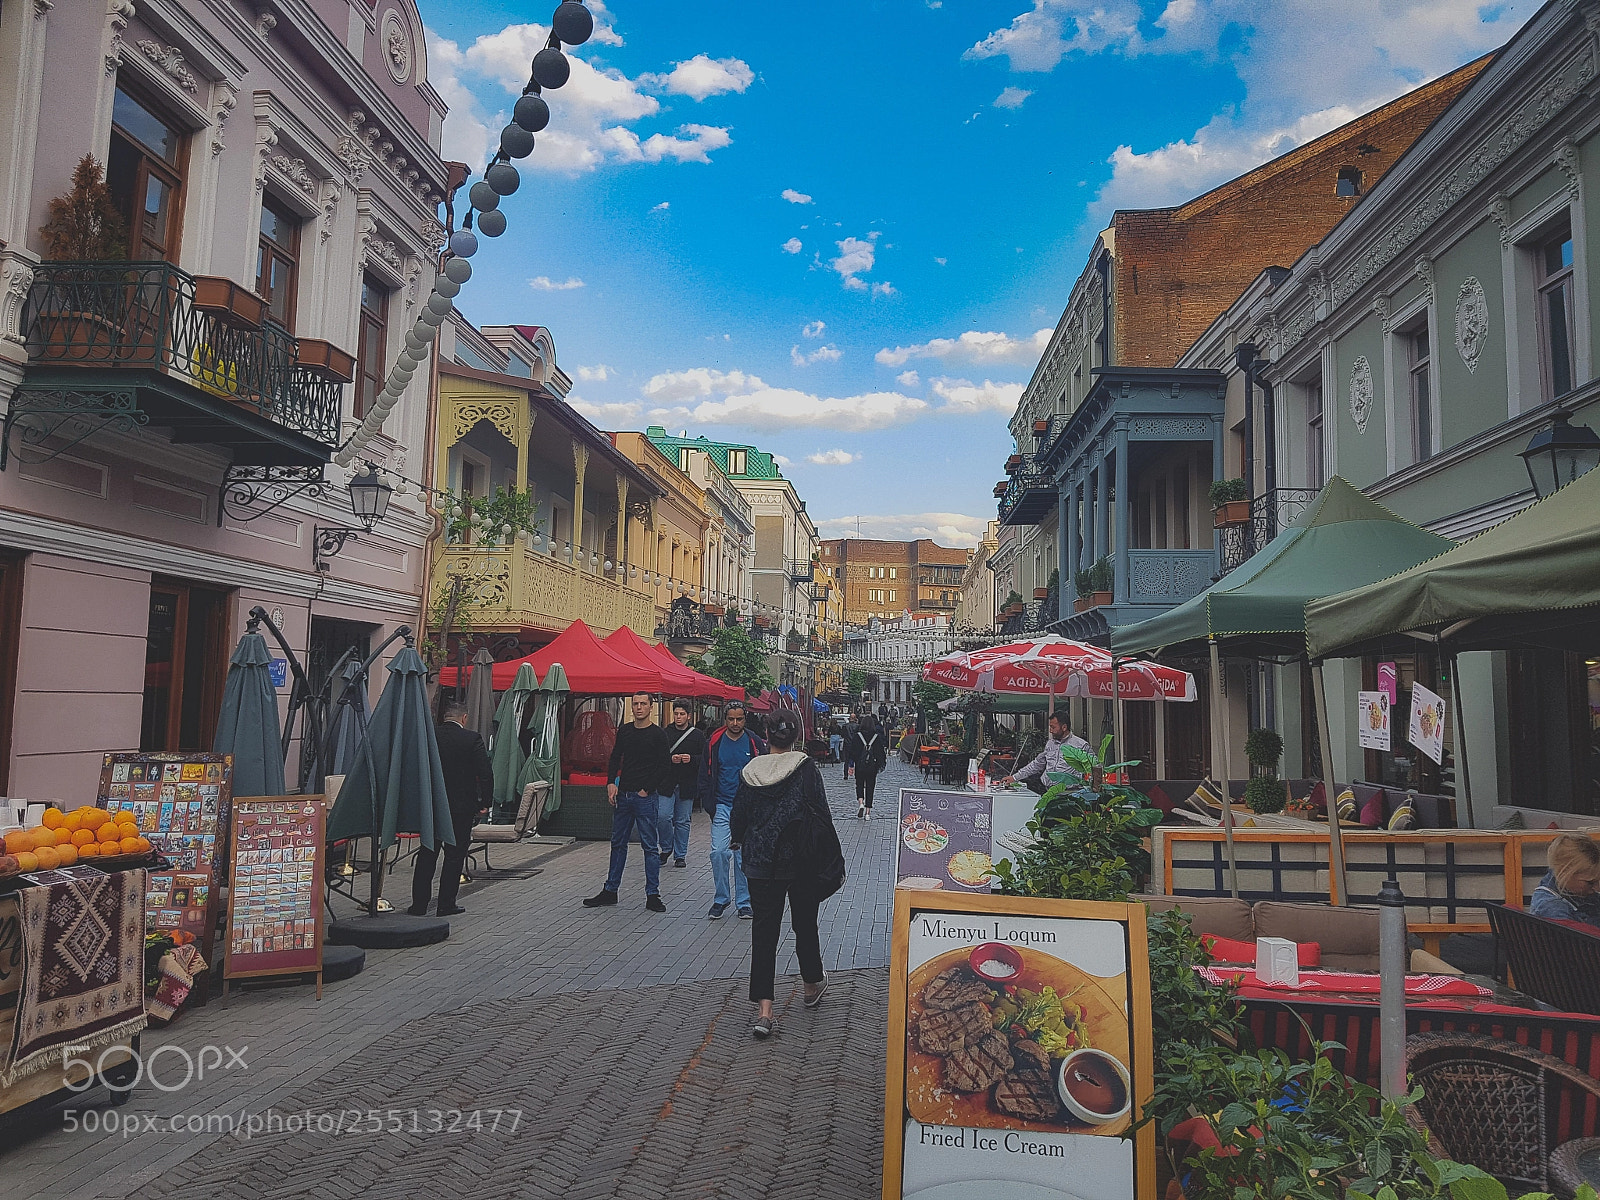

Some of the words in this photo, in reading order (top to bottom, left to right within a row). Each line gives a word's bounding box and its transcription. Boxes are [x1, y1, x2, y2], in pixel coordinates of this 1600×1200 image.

[277, 662, 286, 676] 37
[922, 919, 987, 943] Mienyu
[993, 922, 1057, 946] Loqum
[919, 1124, 965, 1148] Fried
[972, 1129, 998, 1151] Ice
[1004, 1132, 1065, 1157] Cream
